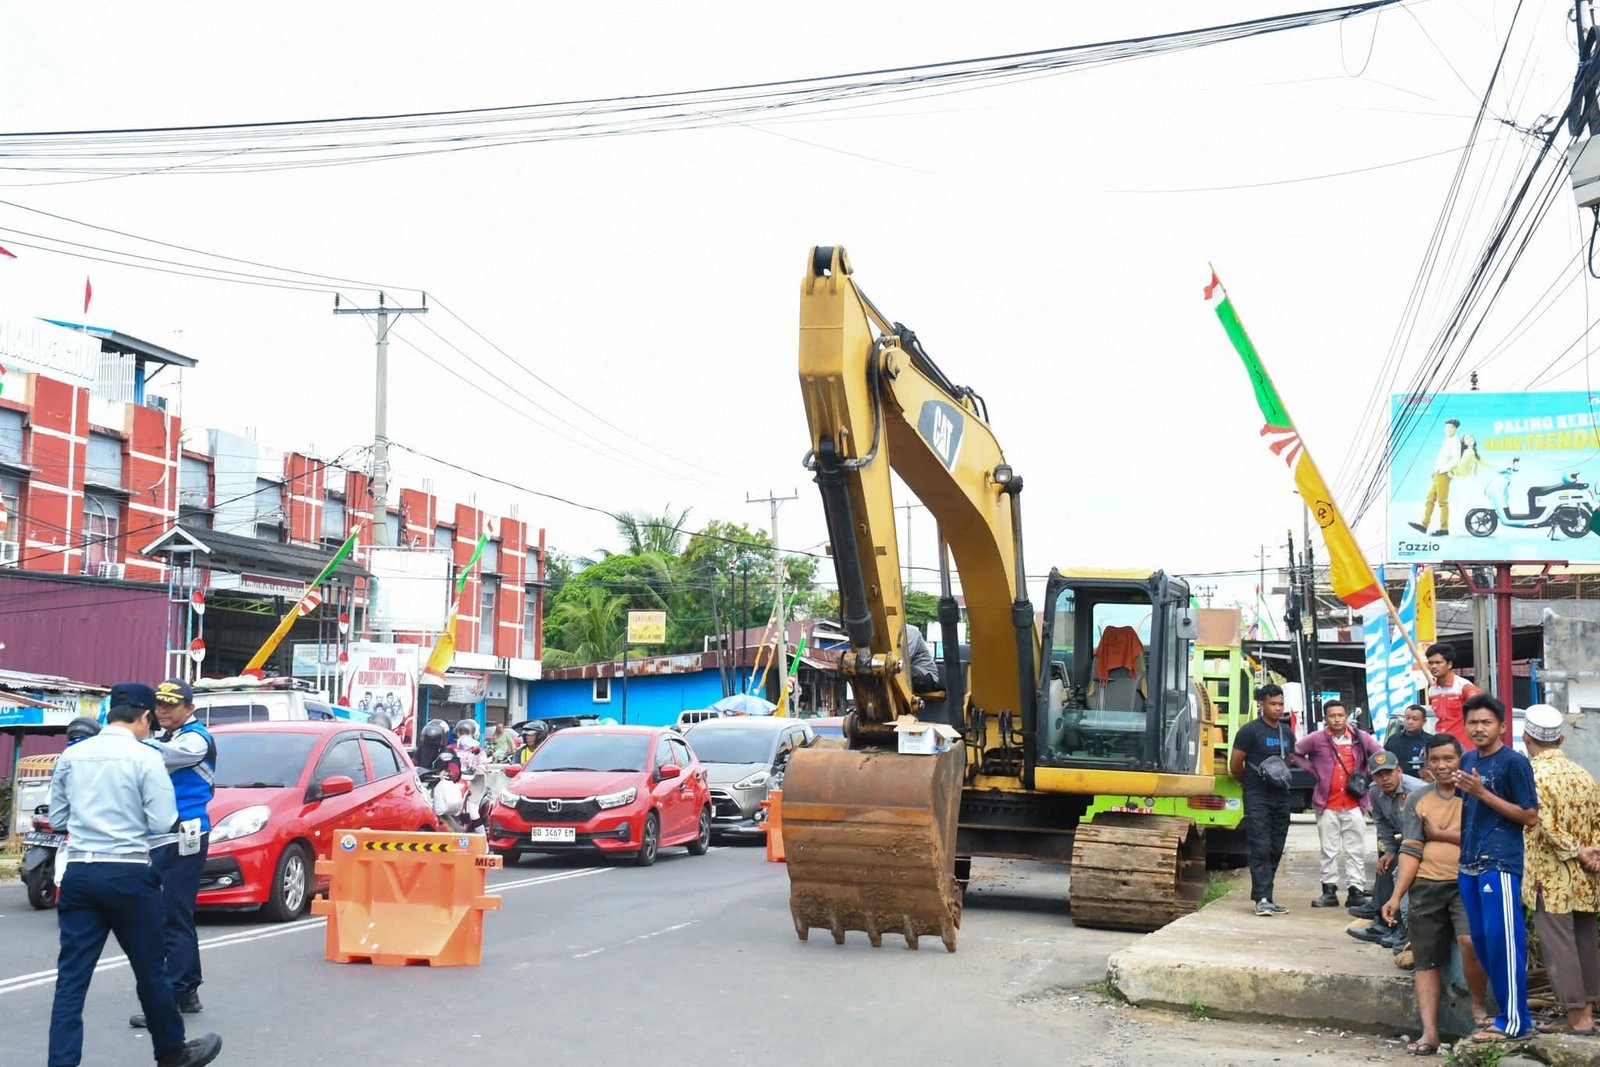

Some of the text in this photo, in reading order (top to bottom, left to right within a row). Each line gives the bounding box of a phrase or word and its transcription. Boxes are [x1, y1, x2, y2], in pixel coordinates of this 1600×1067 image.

[933, 405, 953, 463] CAT
[1398, 541, 1440, 551] Fazzio
[532, 828, 542, 837] BD
[564, 828, 574, 838] EM
[475, 858, 496, 867] MIG
